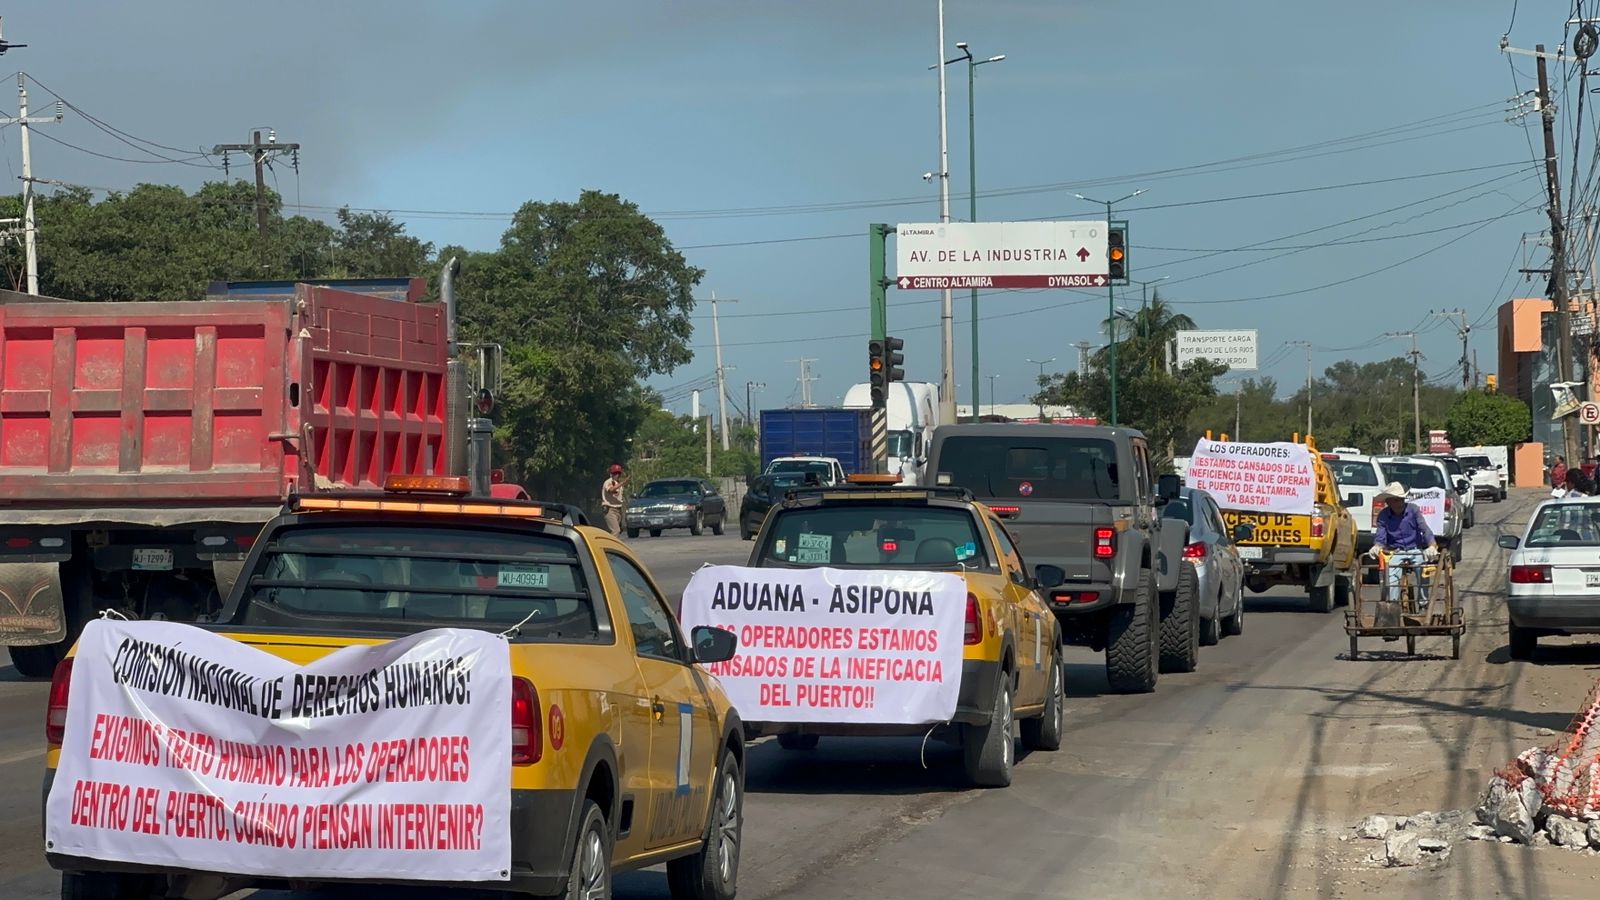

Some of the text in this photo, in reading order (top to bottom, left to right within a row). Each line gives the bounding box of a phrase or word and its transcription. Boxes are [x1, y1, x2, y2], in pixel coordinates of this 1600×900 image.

[910, 249, 1067, 262] AV. DE LA INDUSTRIA
[913, 276, 993, 288] CENTRO ALTAMIRA
[1048, 276, 1092, 286] DYNASOL
[1209, 444, 1291, 458] LOS OPERADORES:
[1238, 460, 1281, 473] CANSADOS
[1284, 463, 1296, 474] DE
[1297, 464, 1308, 475] LA
[1189, 468, 1311, 486] INEFICIENCIA EN QUE OPERAN
[1197, 480, 1299, 498] EL PUERTO DE ALTAMIRA,
[1226, 493, 1271, 506] YA BASTA!!
[1274, 514, 1293, 526] DE
[502, 572, 544, 585] WU-4099-A
[711, 582, 805, 612] ADUANA
[829, 585, 934, 616] ASIPONA
[741, 624, 938, 652] OPERADORES ESTAMOS
[706, 654, 943, 683] ANSADOS DE LA INEFICACIA
[113, 638, 188, 697] COMISIÓN
[187, 655, 261, 716] NACIONAL
[261, 675, 285, 720] DE
[291, 668, 380, 719] DERECHOS
[760, 683, 875, 709] DEL PUERTO!!
[89, 713, 470, 788] EXIGIMOS TRATO HUMANO PARA LOS OPERADORES
[71, 780, 484, 851] DENTRO DEL PUERTO. CUÁNDO PIENSAN INTERVENIR?
